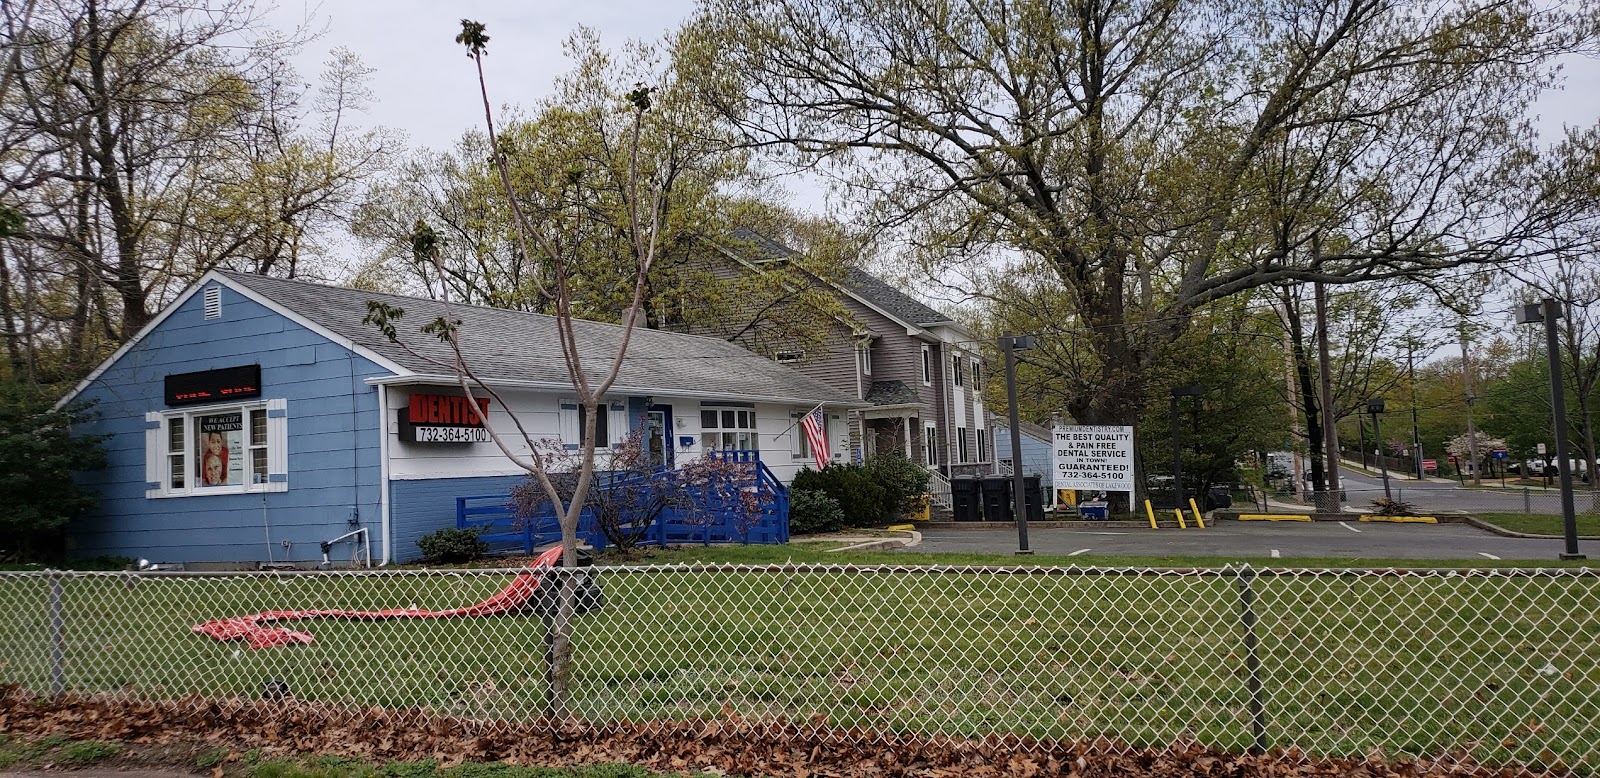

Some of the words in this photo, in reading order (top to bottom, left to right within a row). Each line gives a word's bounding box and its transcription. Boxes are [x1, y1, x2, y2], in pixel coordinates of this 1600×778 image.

[409, 394, 490, 425] DENTIST
[420, 428, 487, 442] 732-364-5100
[1058, 463, 1129, 471] GUARANTEED!
[1061, 471, 1124, 479] 732-364-5100
